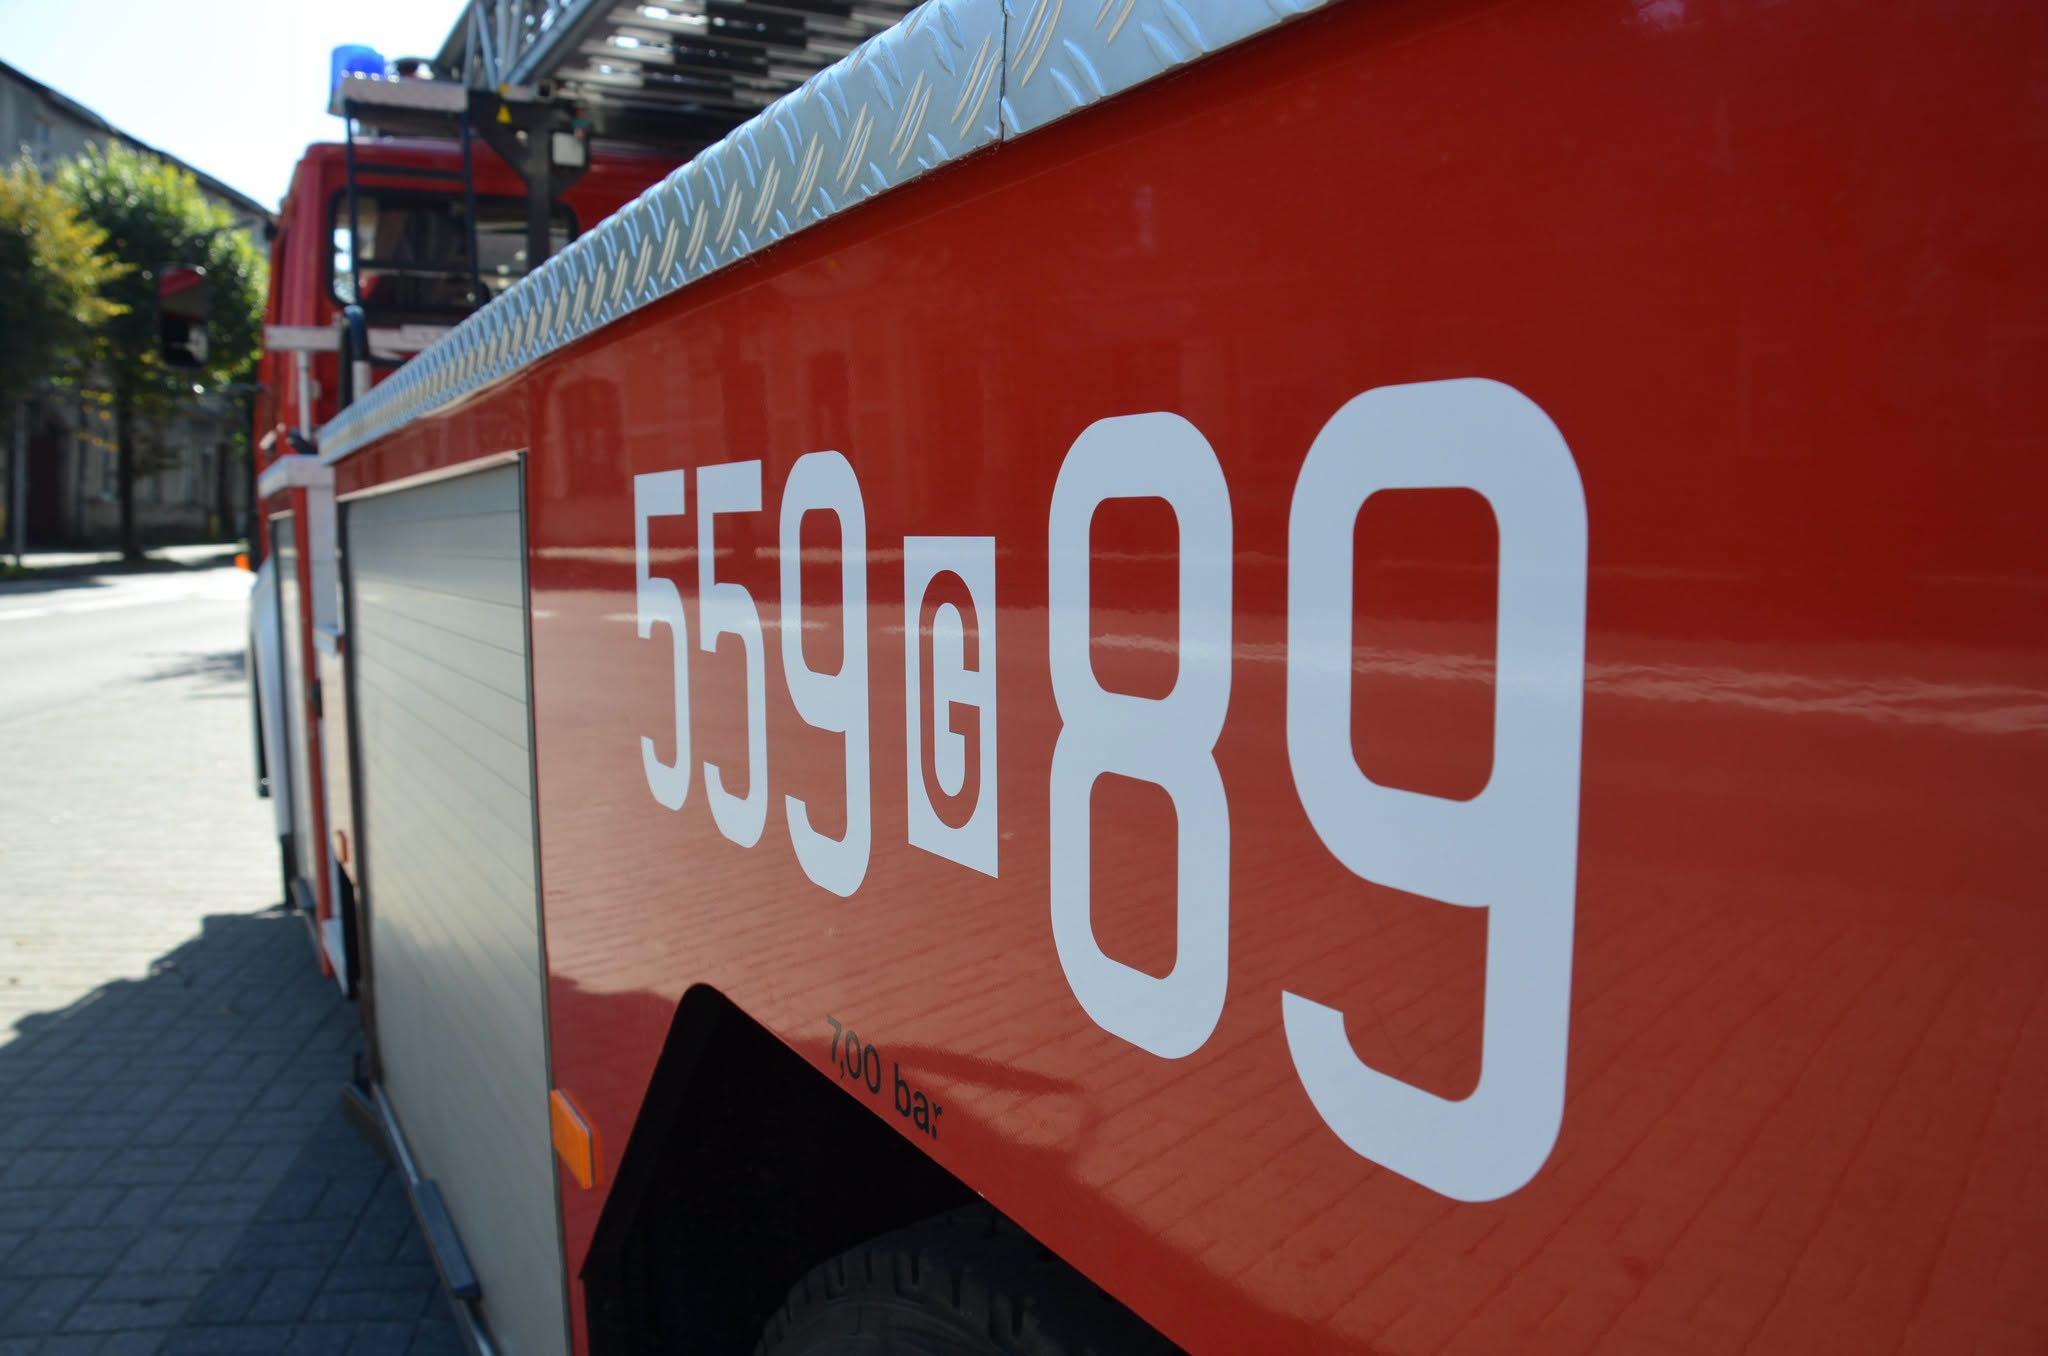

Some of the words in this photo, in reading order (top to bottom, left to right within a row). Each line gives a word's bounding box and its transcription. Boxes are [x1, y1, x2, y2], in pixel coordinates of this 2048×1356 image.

[634, 450, 872, 898] 559
[919, 569, 981, 830] G
[1049, 377, 1588, 1203] 89
[827, 1015, 881, 1095] 7,00
[894, 1062, 943, 1140] bar
